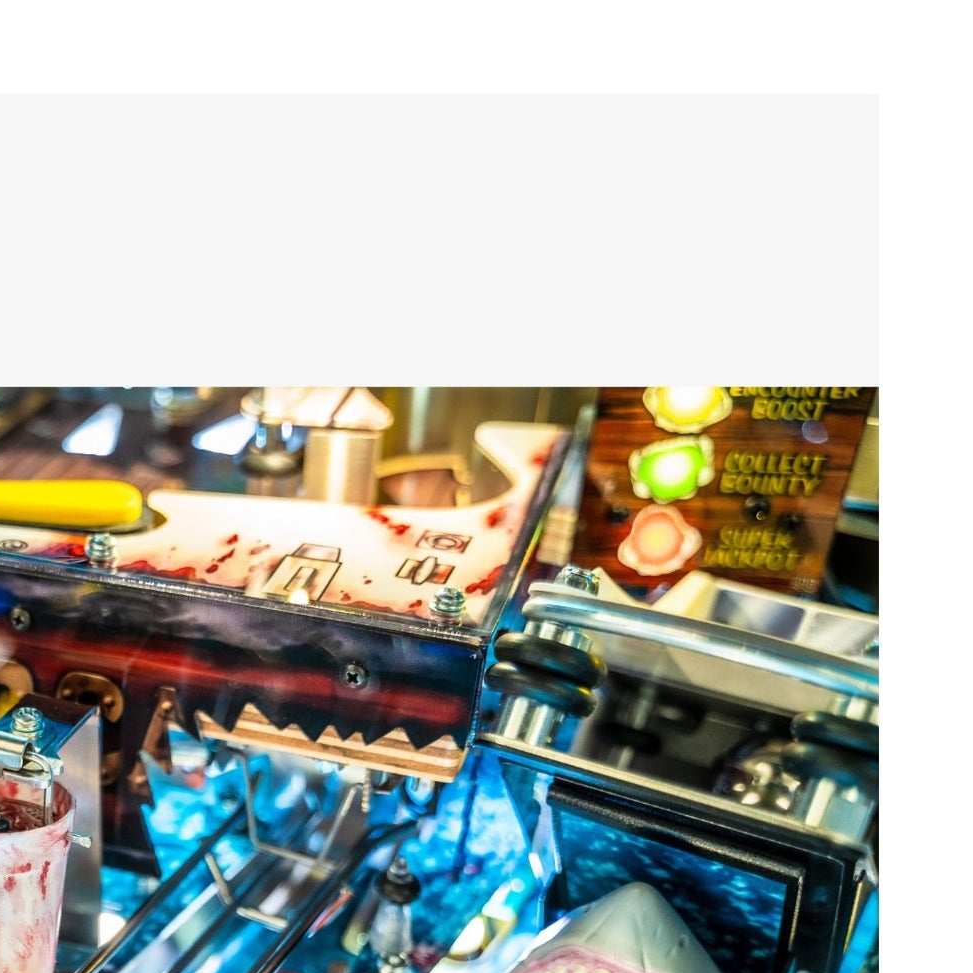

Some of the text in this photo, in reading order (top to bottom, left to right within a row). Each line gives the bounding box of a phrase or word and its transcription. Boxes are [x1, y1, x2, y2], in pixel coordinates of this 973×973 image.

[751, 397, 829, 421] BOOST
[725, 451, 827, 475] COLLECT
[720, 473, 821, 496] BOUNTY
[719, 526, 795, 549] SUPER
[699, 548, 803, 571] JACKPOT
